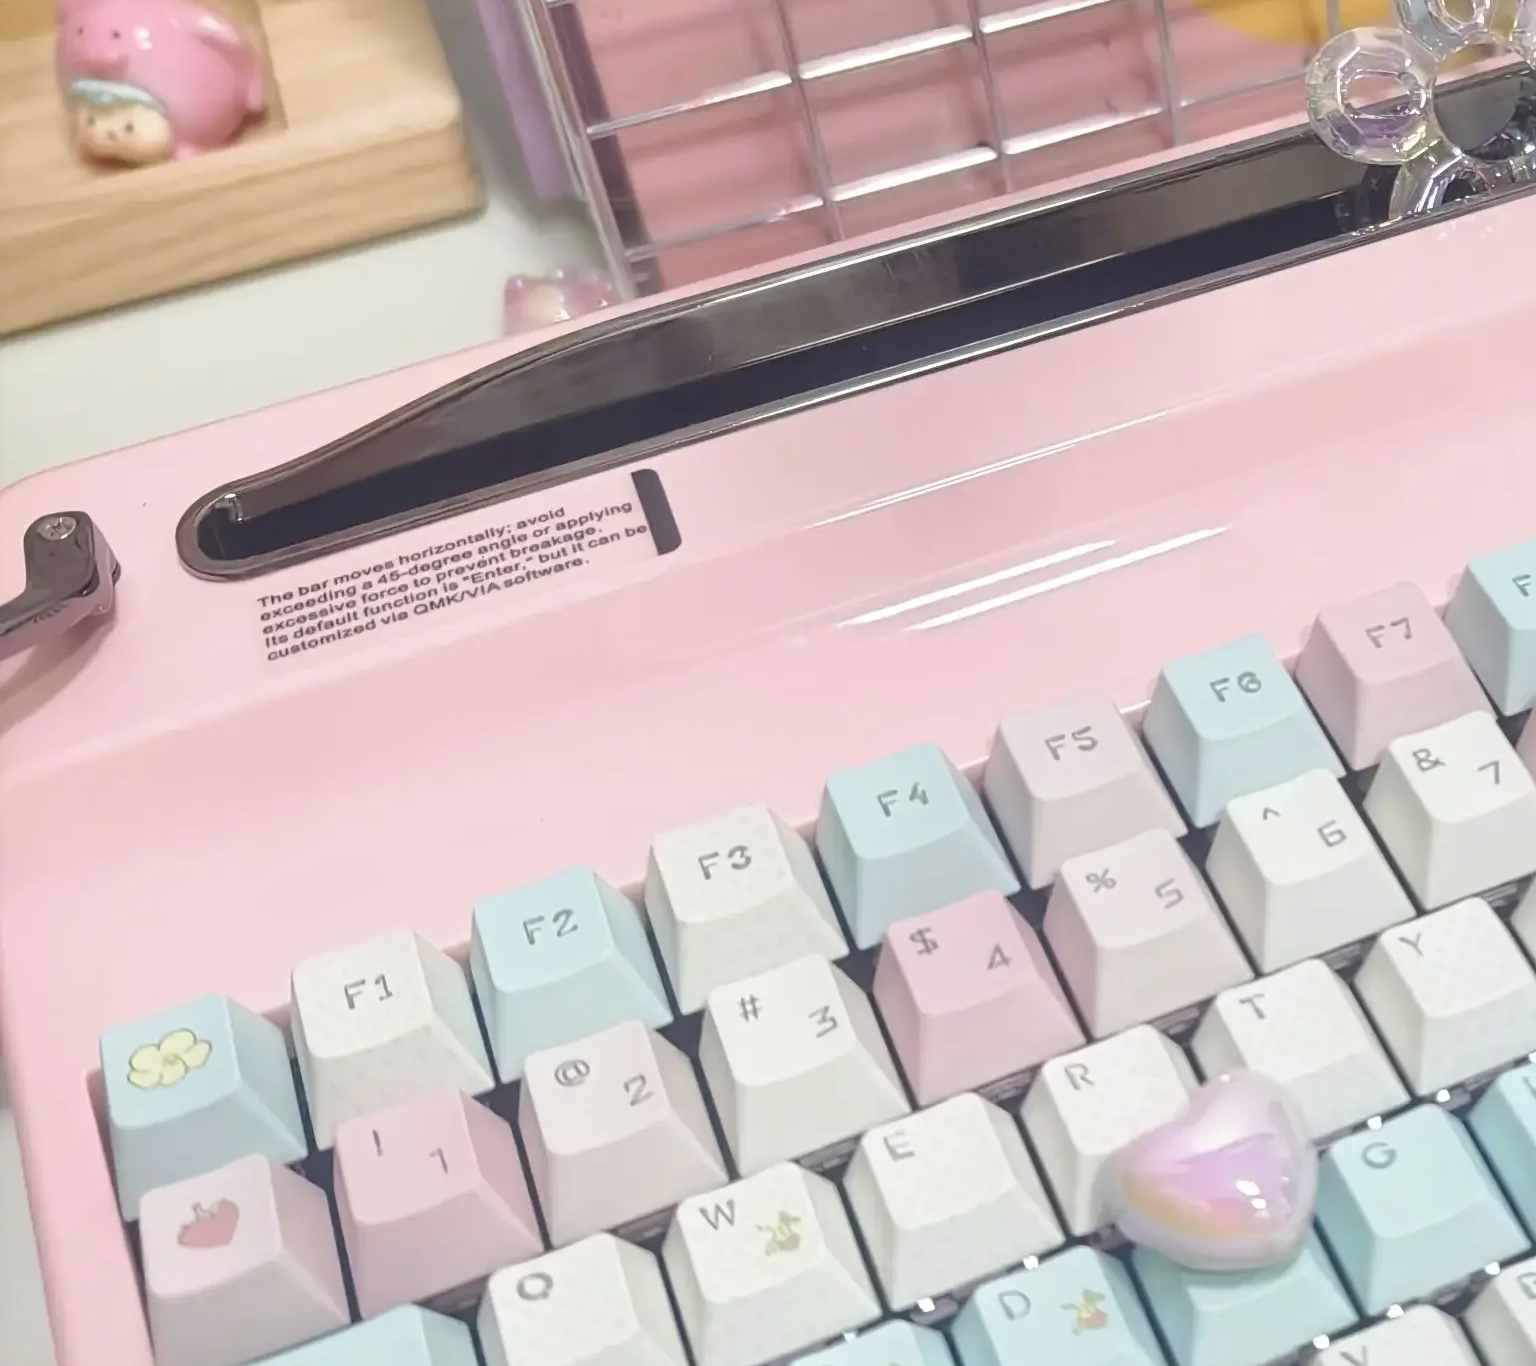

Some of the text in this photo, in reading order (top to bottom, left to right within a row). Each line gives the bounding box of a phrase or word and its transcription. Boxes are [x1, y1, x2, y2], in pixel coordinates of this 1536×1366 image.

[257, 507, 565, 607] The bar moves horizontally; avoid
[261, 502, 632, 621] exceeding a 45-degree angle or applying
[263, 527, 602, 634] excessive force to prevent breakage.
[265, 636, 288, 648] Its
[293, 611, 359, 638] default
[364, 587, 438, 616] function
[443, 581, 458, 592] is
[538, 548, 568, 563] but
[572, 542, 584, 553] it
[588, 533, 620, 548] can
[625, 525, 647, 538] be
[267, 559, 589, 661] customized via QMK/VIA software.
[1365, 616, 1413, 649] F7
[1209, 671, 1262, 703] F6
[1044, 725, 1099, 761] F5
[1411, 748, 1501, 785] & 7
[876, 782, 929, 818] F4
[1317, 819, 1347, 848] 6
[697, 844, 752, 881] F3
[1084, 868, 1185, 910] % 5
[522, 908, 579, 946] F2
[1398, 933, 1423, 956] Y
[909, 927, 1011, 971] $ 4
[343, 974, 393, 1010] F1
[1238, 993, 1266, 1020] T
[738, 995, 839, 1039] # 3
[553, 1059, 653, 1107] @ 2
[1064, 1063, 1094, 1091] R
[429, 1147, 449, 1174] 1
[883, 1136, 916, 1162] E
[1361, 1142, 1397, 1170] G
[698, 1199, 735, 1231] W
[516, 1272, 554, 1302] Q
[998, 1290, 1032, 1321] D
